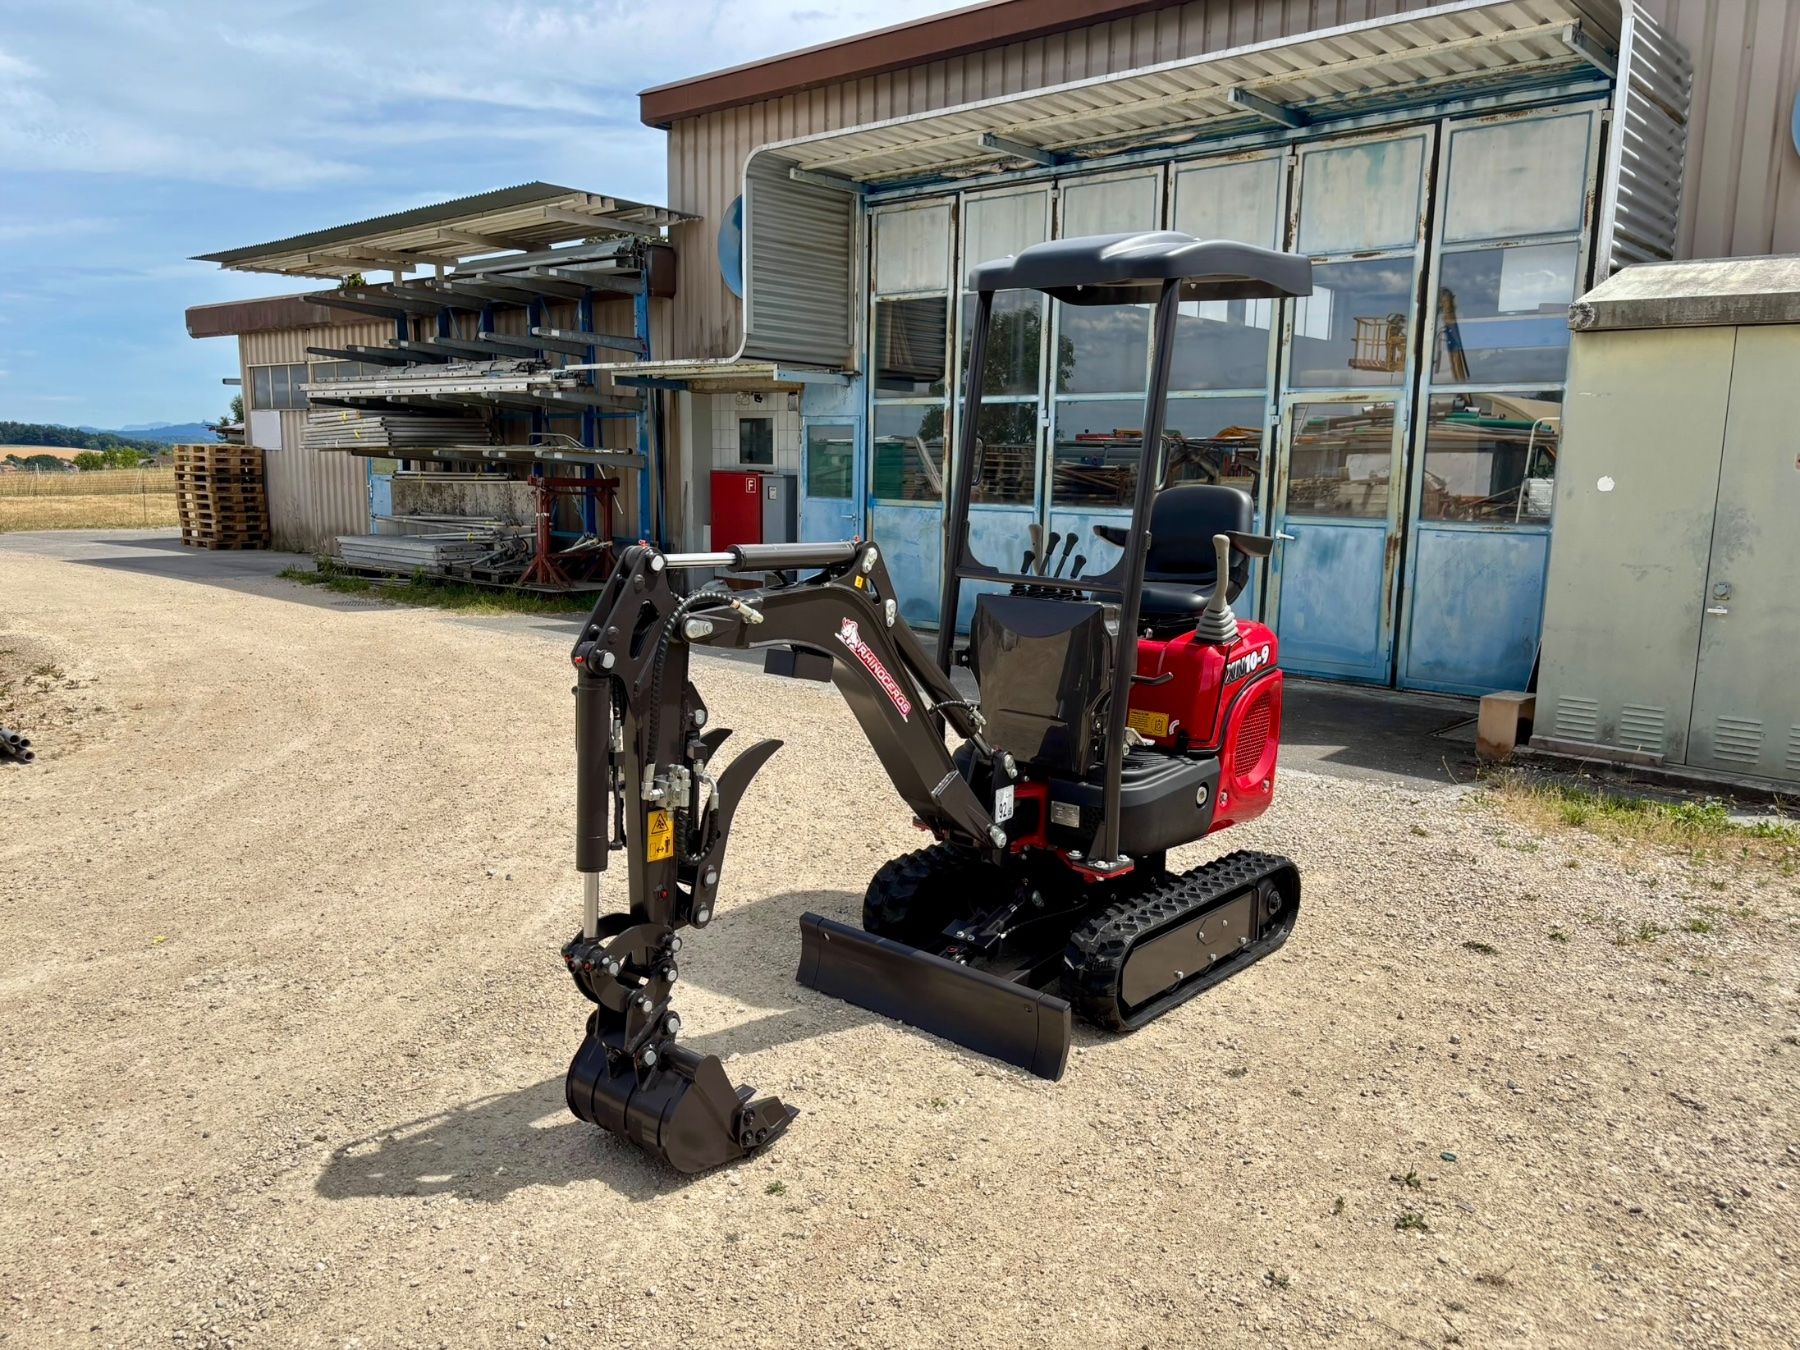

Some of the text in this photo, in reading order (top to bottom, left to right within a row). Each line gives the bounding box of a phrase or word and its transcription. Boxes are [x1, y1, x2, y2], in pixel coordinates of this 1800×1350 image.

[748, 479, 754, 491] F
[857, 644, 911, 714] RHINOCEROS
[1224, 645, 1270, 684] XN10-9
